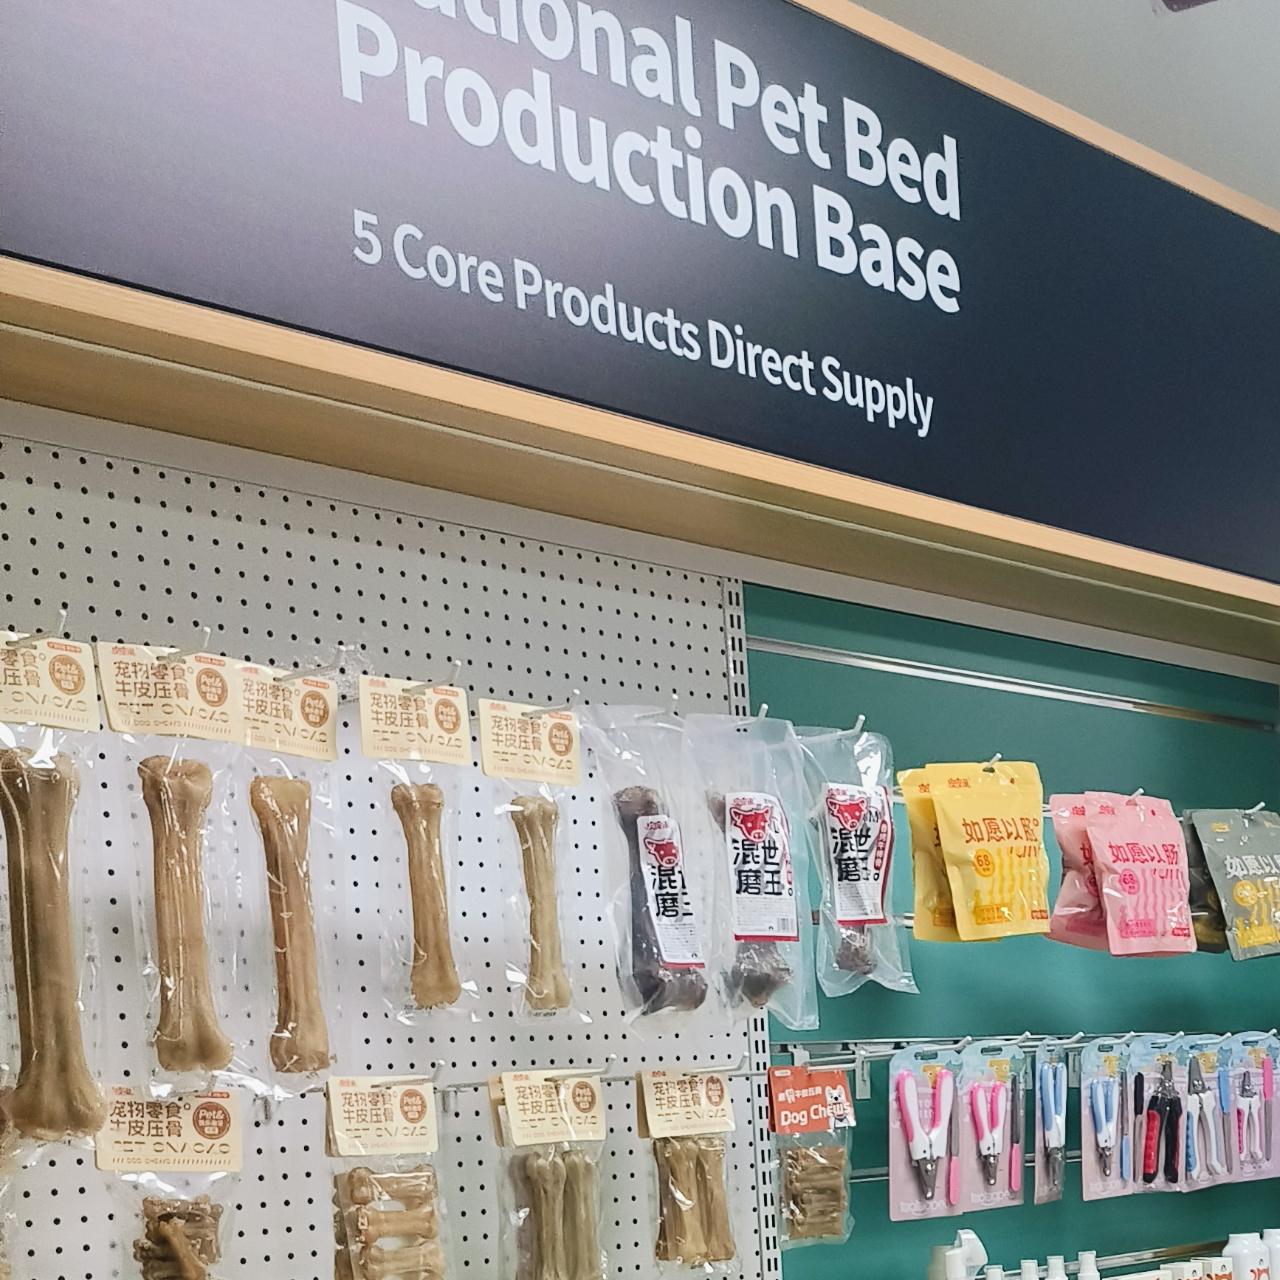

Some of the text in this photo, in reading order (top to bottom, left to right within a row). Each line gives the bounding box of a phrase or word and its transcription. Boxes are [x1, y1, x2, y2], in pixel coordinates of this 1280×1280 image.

[335, 0, 961, 313] Production Base
[714, 39, 831, 170] Pet
[843, 97, 961, 221] Bed
[352, 208, 934, 437] 5 Core Products Direct Supply
[780, 1101, 851, 1126] Dog Chews
